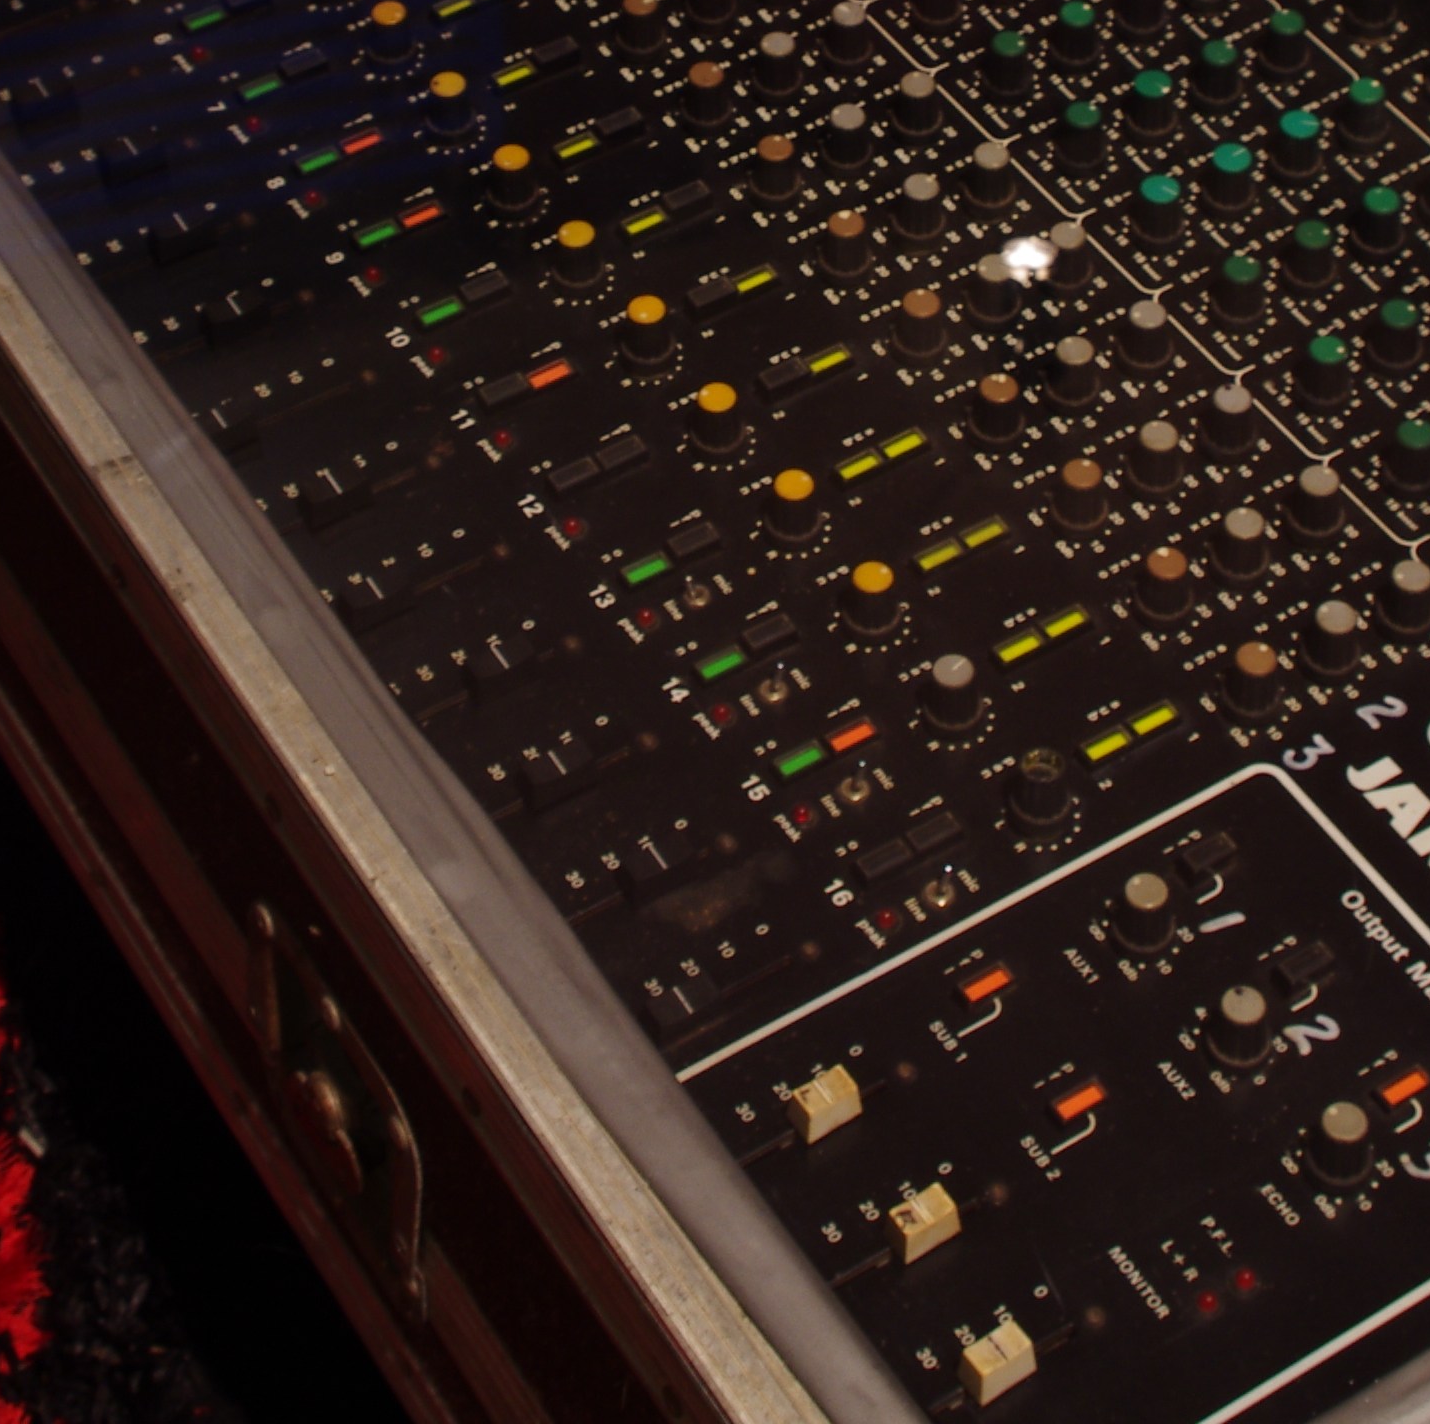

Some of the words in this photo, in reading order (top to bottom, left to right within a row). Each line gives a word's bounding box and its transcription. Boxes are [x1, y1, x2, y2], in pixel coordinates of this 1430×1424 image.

[325, 252, 344, 264] 9
[385, 327, 410, 347] 10
[451, 409, 476, 429] 11
[518, 494, 544, 518] 12
[589, 584, 616, 608] 13
[662, 677, 690, 702] 14
[1355, 696, 1407, 729] 2
[693, 712, 720, 739] peak
[1282, 733, 1336, 771] 3
[741, 774, 771, 801] 15
[873, 768, 894, 789] mic
[773, 814, 801, 842] peak
[957, 869, 979, 892] mic
[824, 879, 853, 906] 16
[904, 898, 926, 921] line
[854, 916, 887, 950] peak
[1340, 888, 1412, 964] Output
[718, 941, 735, 958] 10
[680, 958, 700, 976] 20
[1063, 949, 1098, 983] AUX1
[644, 978, 663, 996] 30
[928, 1019, 955, 1048] SUB
[956, 1052, 967, 1062] 1
[1283, 1014, 1340, 1056] 2
[849, 1045, 863, 1056] 0
[1158, 1062, 1196, 1100] AUX2
[735, 1102, 755, 1122] 30
[938, 1162, 952, 1174] 0
[1019, 1134, 1048, 1165] SUB
[1046, 1168, 1061, 1181] 2
[898, 1181, 917, 1201] 10
[859, 1200, 880, 1220] 20
[1260, 1183, 1301, 1228] ECHO
[821, 1222, 842, 1242] 30
[1033, 1285, 1048, 1298] 0
[1107, 1244, 1171, 1322] MONITOR
[993, 1304, 1012, 1324] 10
[953, 1324, 976, 1346] 20
[916, 1347, 937, 1369] 30
